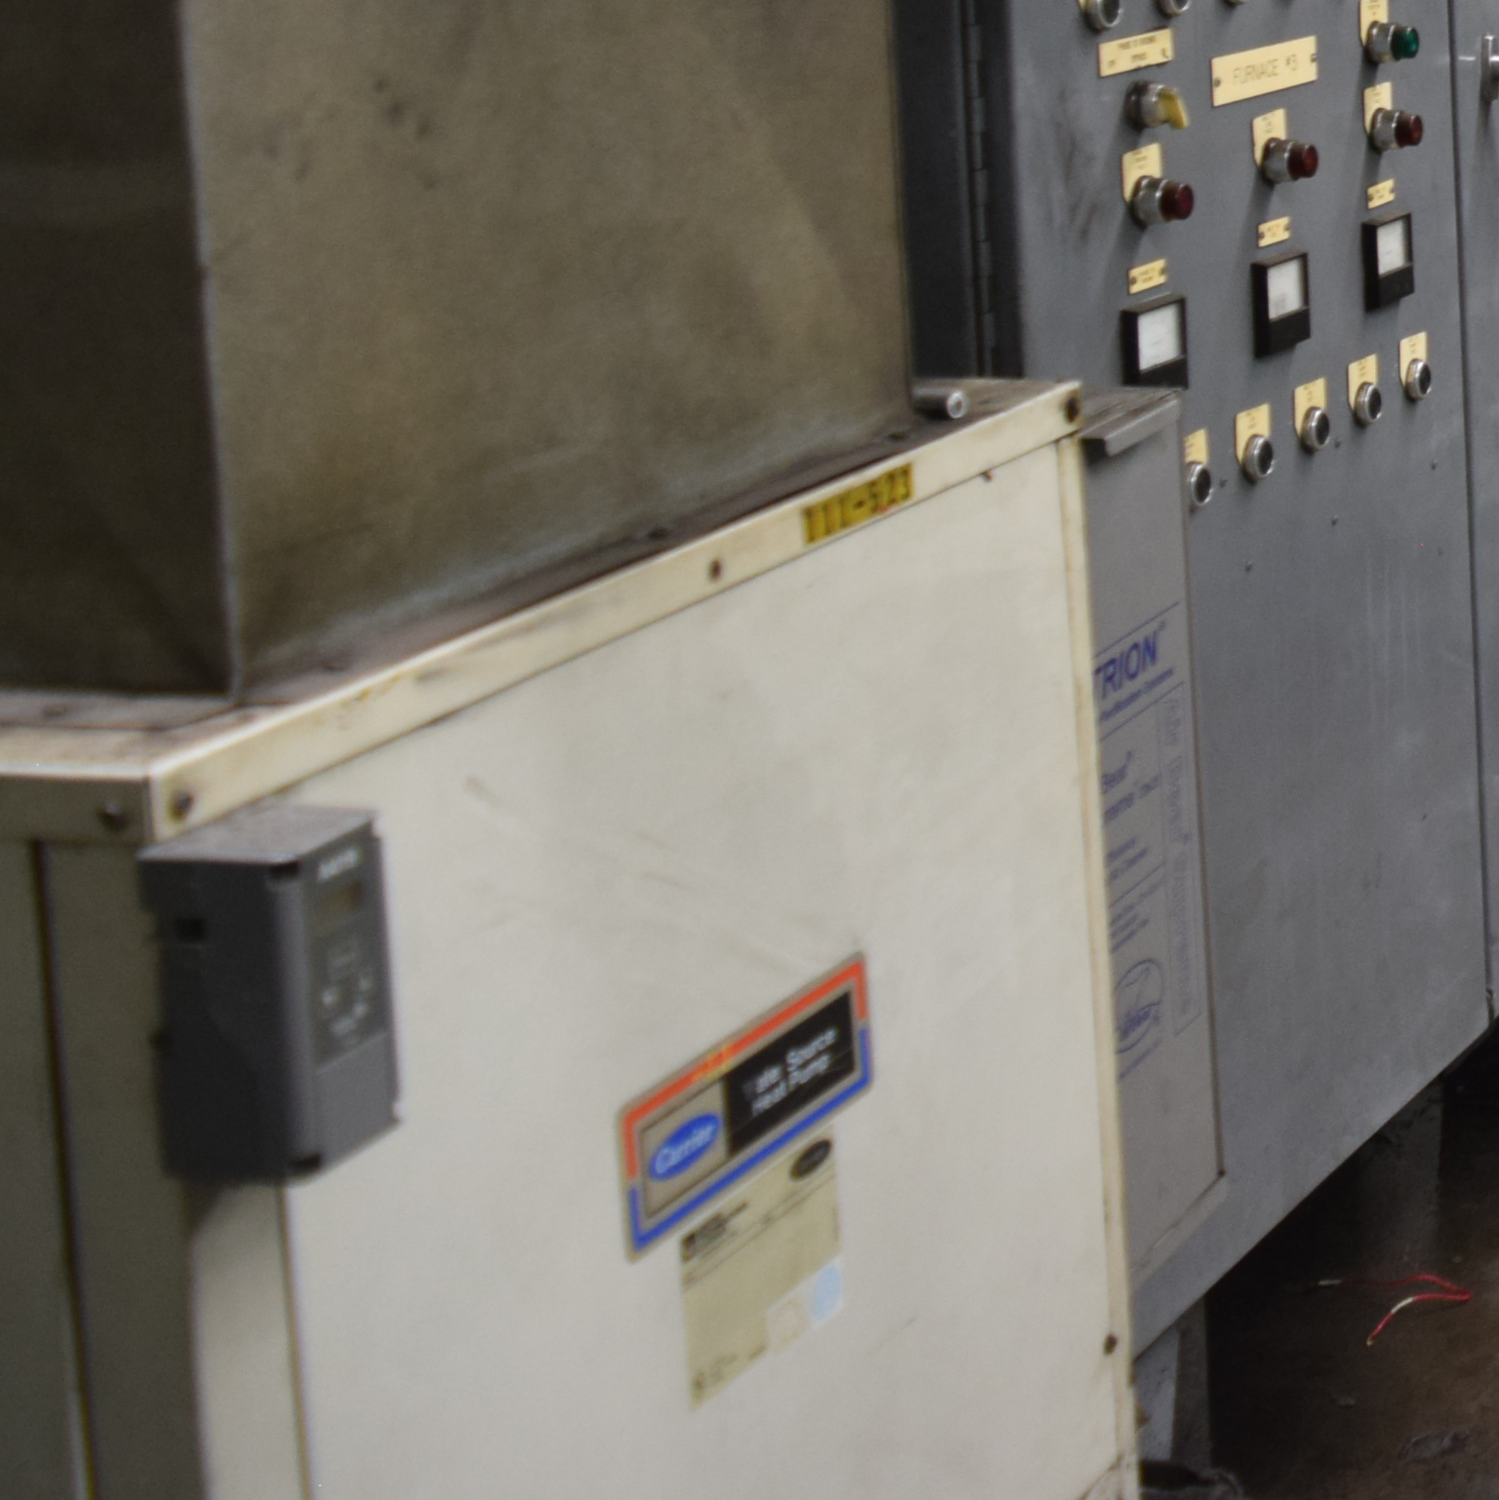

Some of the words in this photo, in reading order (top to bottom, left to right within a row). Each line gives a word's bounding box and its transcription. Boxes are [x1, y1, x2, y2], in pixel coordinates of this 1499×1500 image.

[1232, 57, 1280, 85] FURNACE
[1285, 53, 1298, 72] #3
[655, 1122, 718, 1175] Carrier
